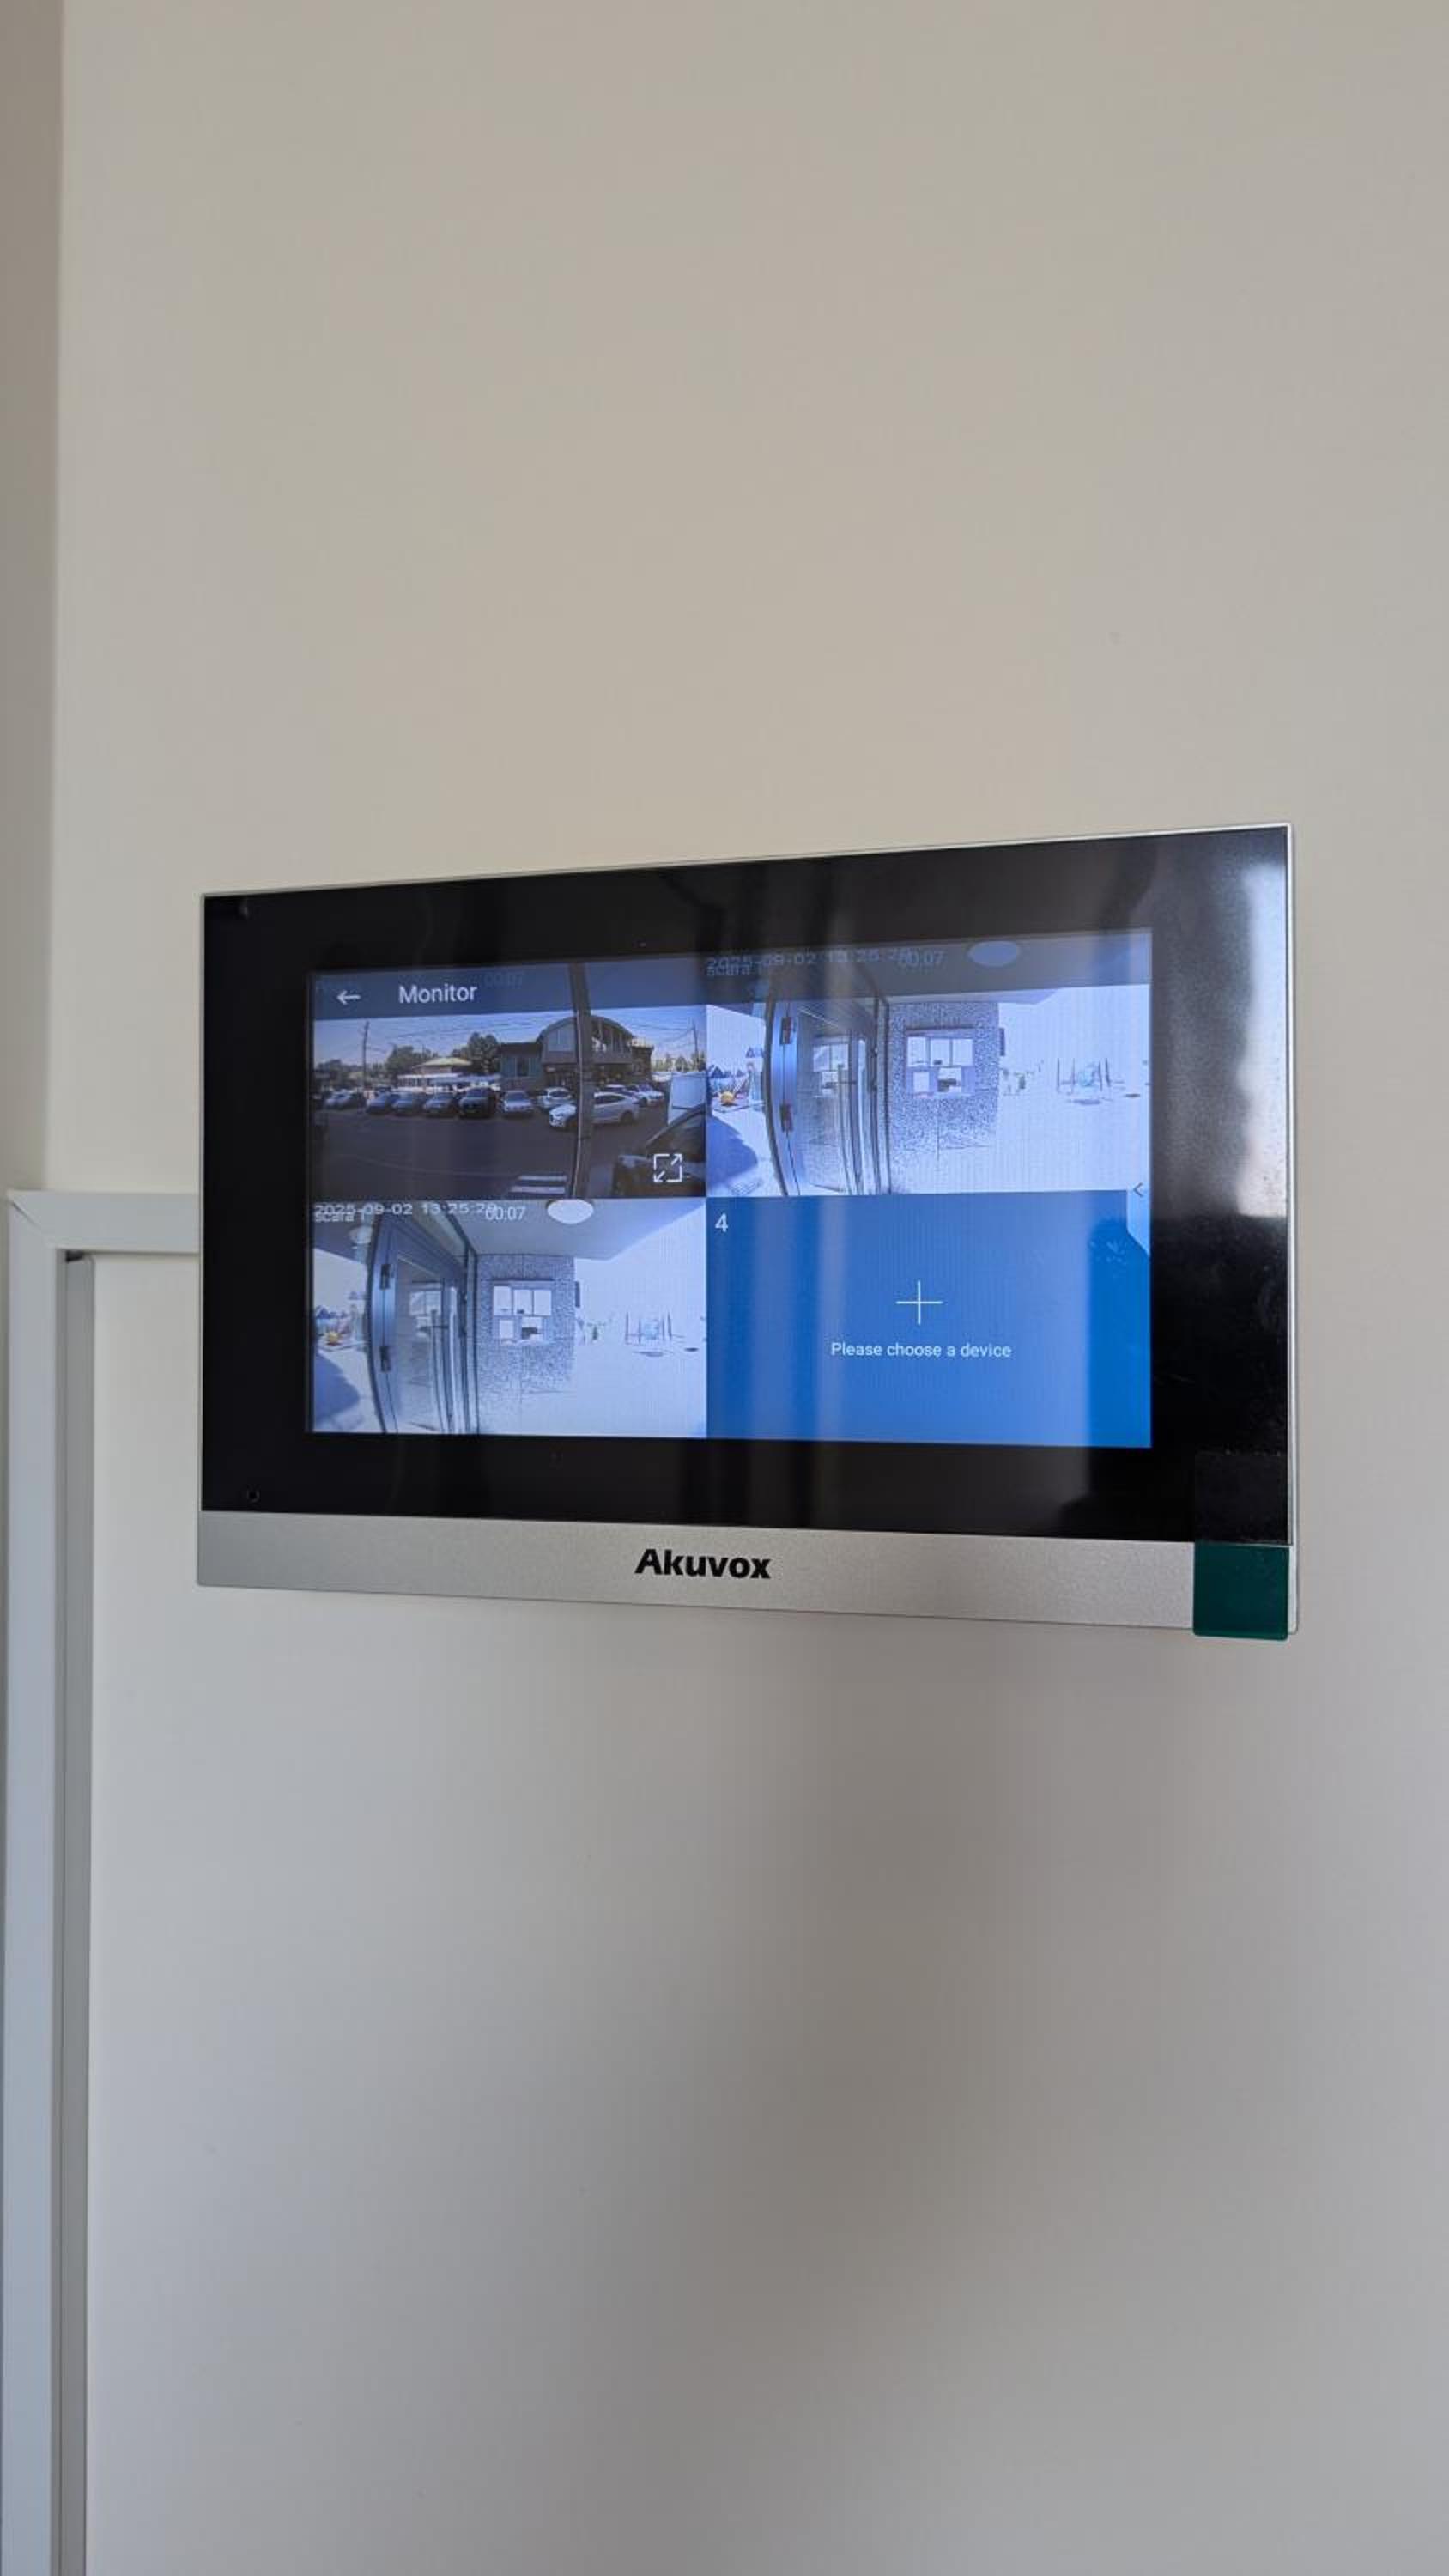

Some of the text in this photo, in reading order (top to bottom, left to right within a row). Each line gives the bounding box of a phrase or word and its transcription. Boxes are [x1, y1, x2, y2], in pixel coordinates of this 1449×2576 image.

[398, 983, 478, 1004] Monitor
[714, 1213, 729, 1233] 4
[830, 1342, 1012, 1358] Please choose a device
[634, 1548, 772, 1579] Akuvox
